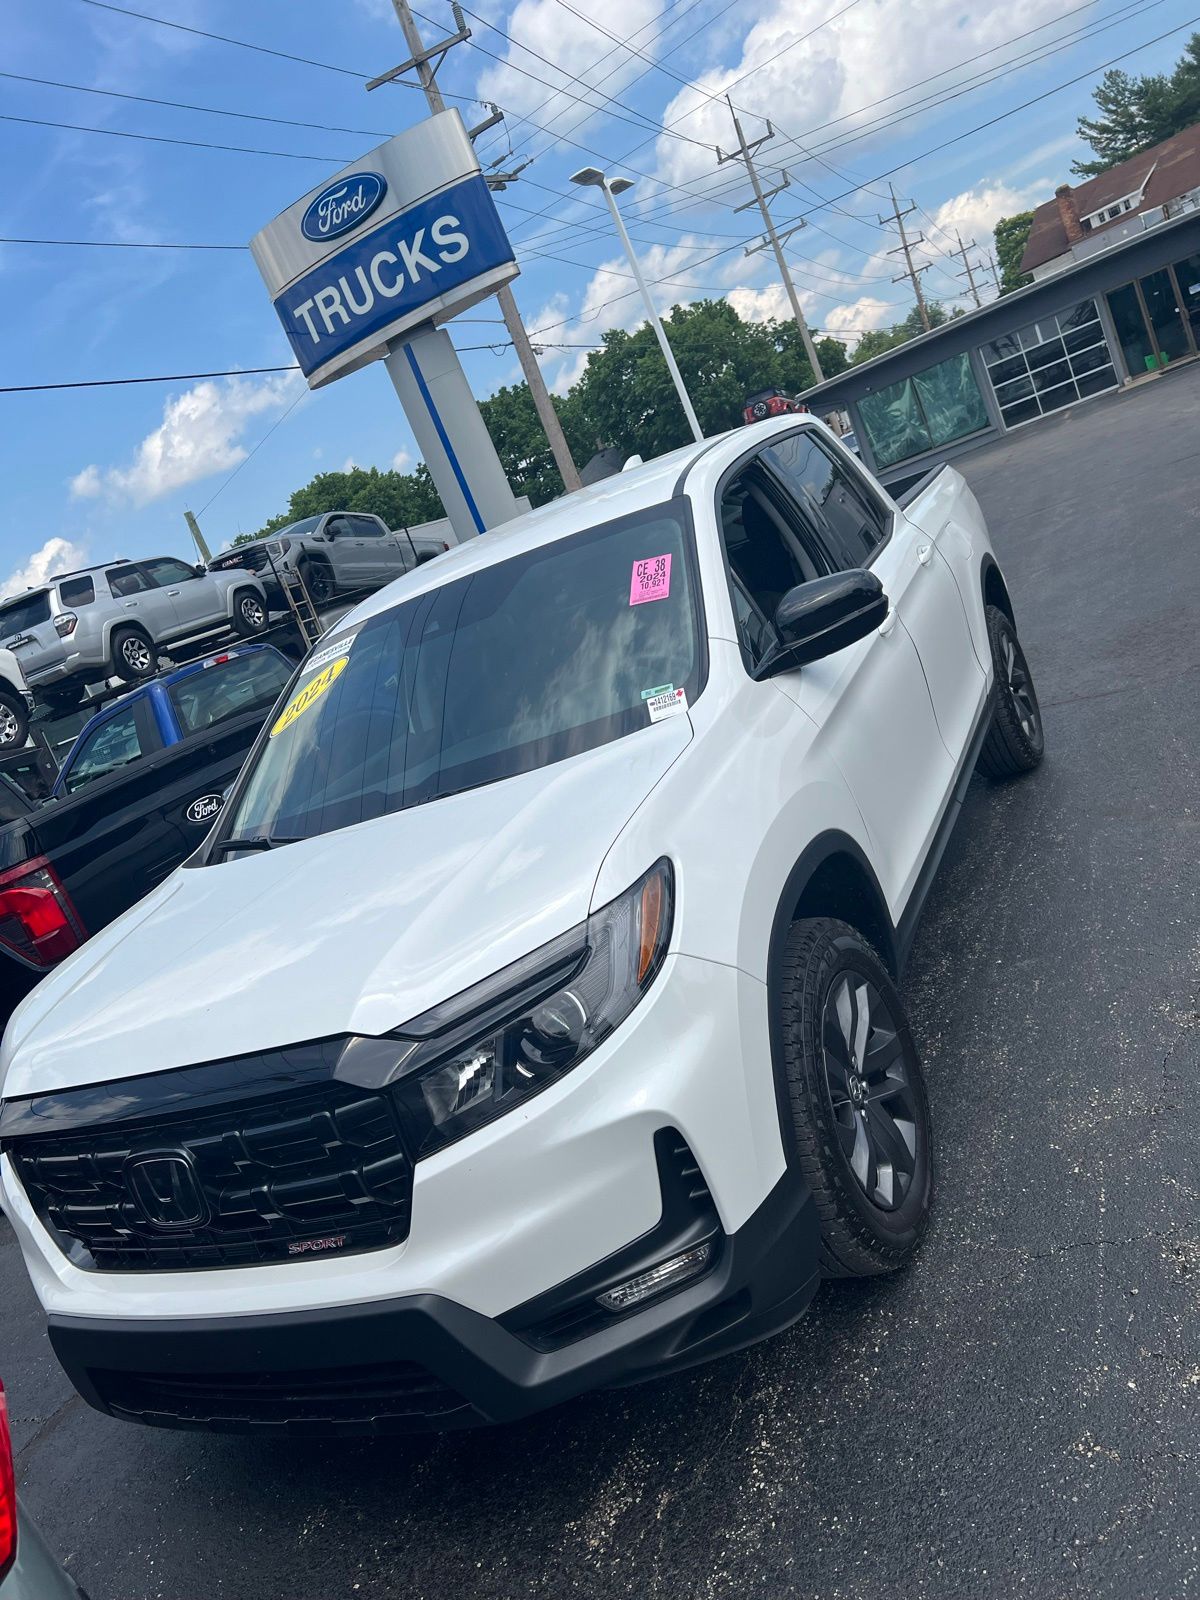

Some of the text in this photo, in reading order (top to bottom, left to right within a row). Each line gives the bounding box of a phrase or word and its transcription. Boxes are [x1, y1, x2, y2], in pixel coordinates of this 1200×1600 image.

[318, 184, 366, 233] Ford
[293, 215, 470, 345] TRUCKS
[221, 555, 244, 568] GMC
[637, 558, 666, 577] CE 38
[640, 571, 666, 583] 2024
[282, 665, 335, 728] 2024
[194, 798, 219, 819] Ford
[288, 1235, 346, 1255] SPORT
